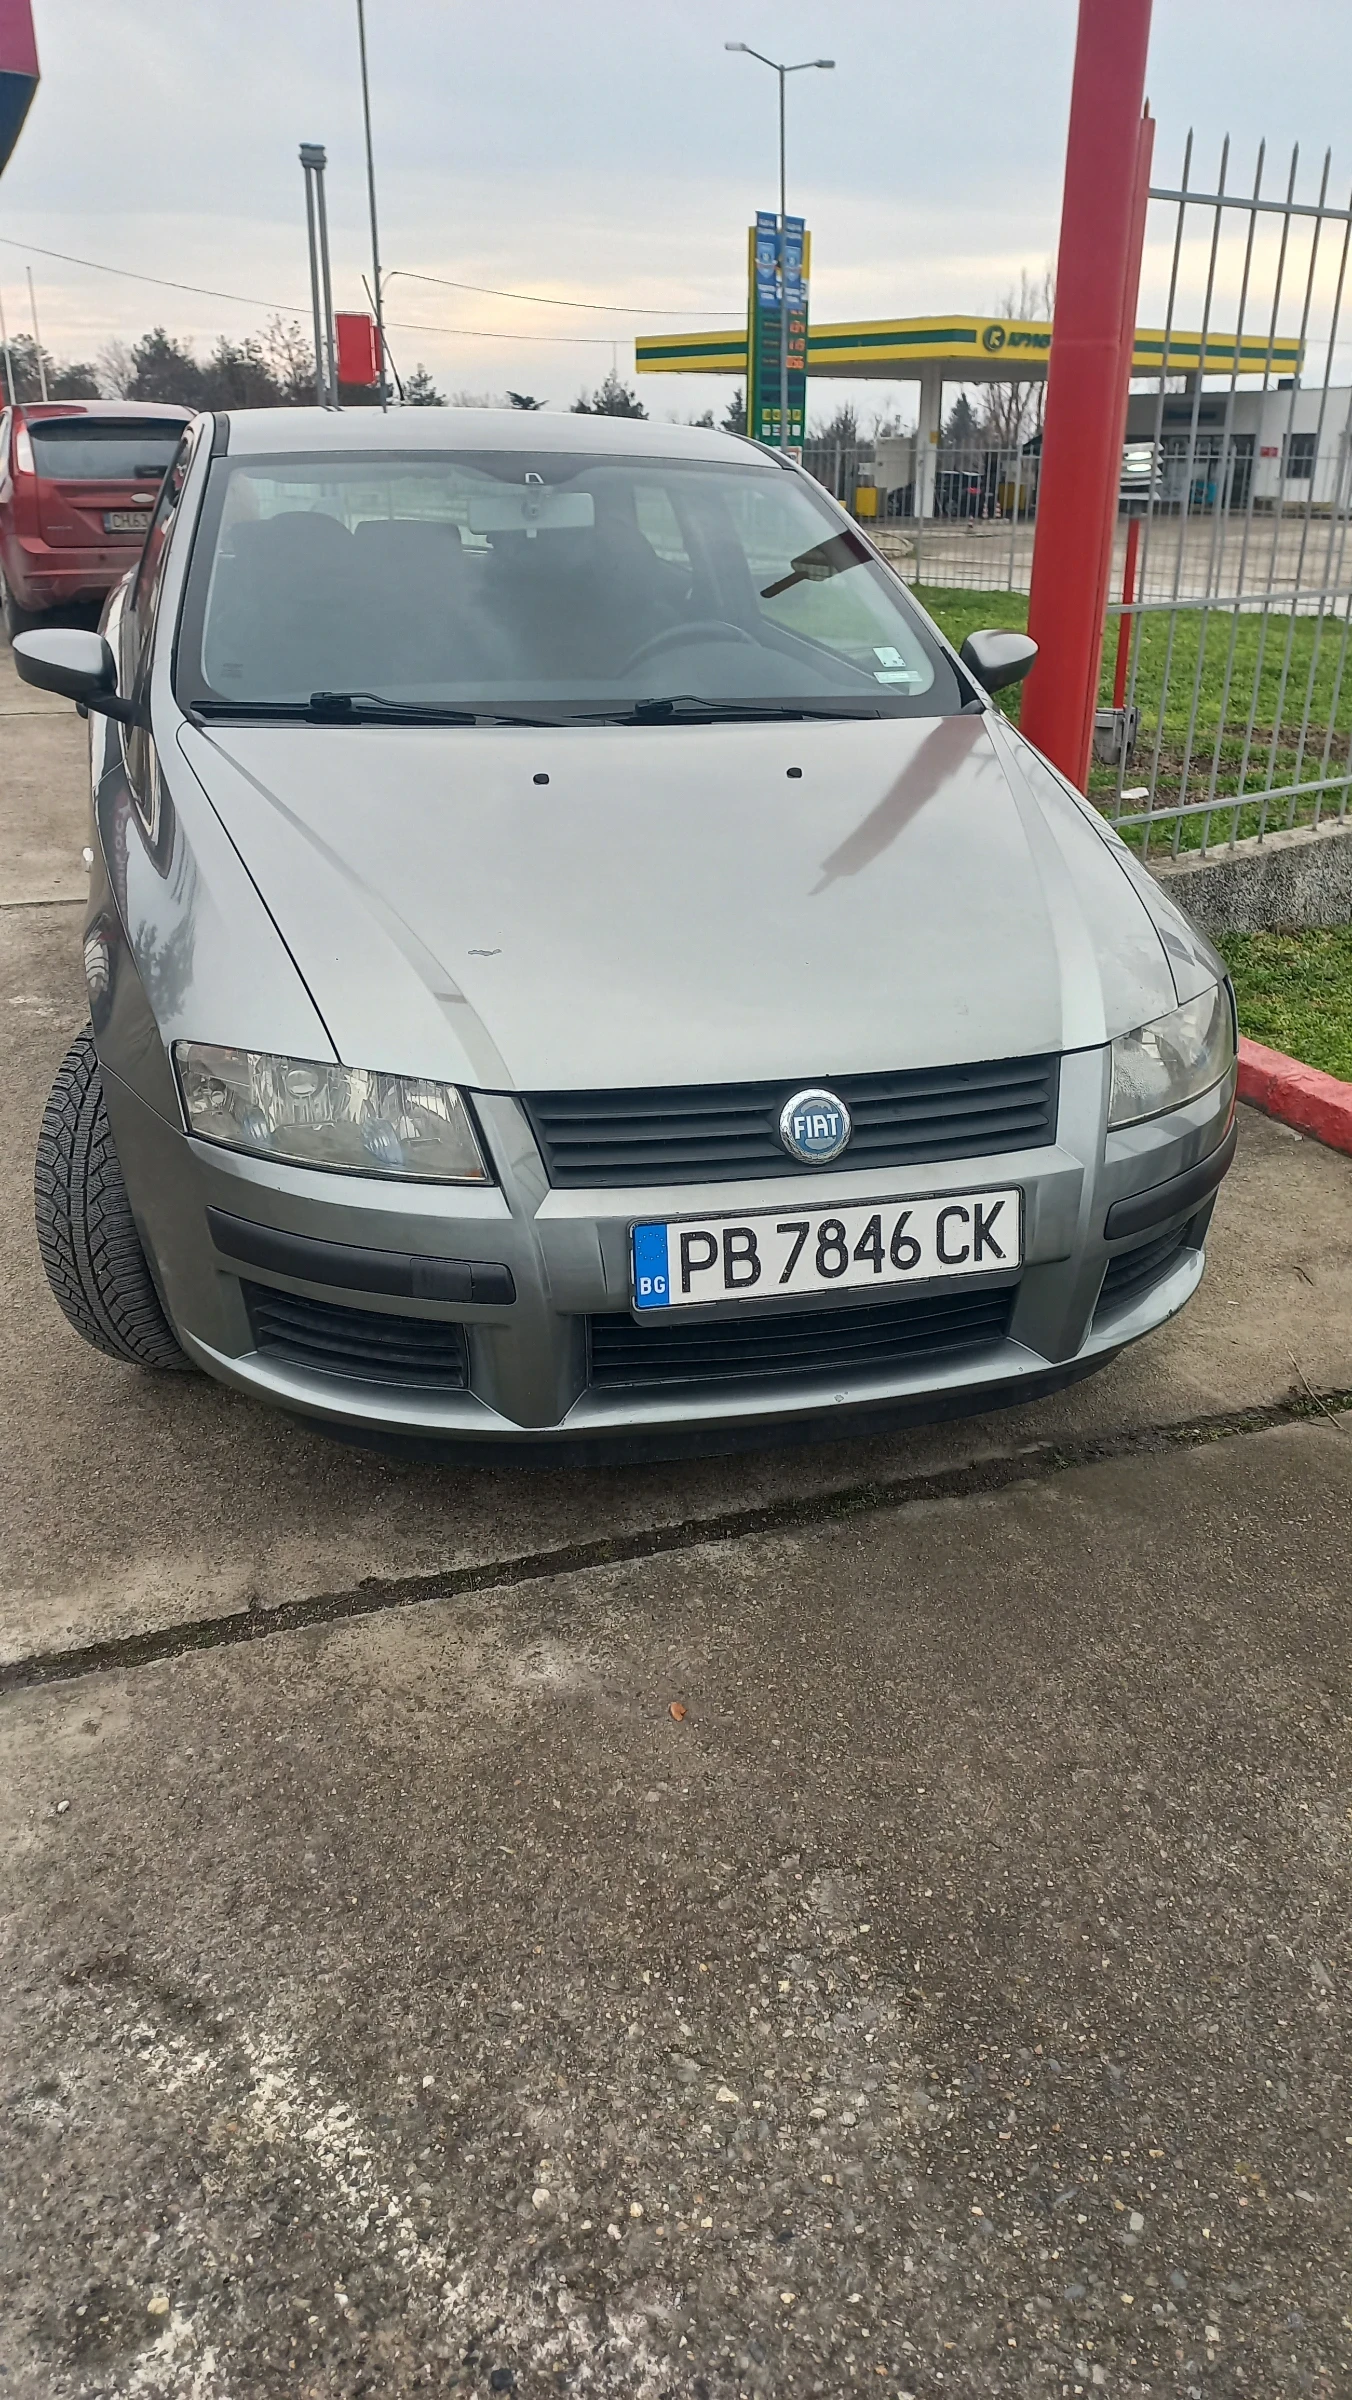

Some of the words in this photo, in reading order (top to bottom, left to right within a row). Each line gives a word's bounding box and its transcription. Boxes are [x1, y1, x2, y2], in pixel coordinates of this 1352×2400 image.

[793, 1113, 840, 1140] FIAT
[680, 1226, 762, 1293] PB
[776, 1210, 922, 1285] 7846
[936, 1200, 1006, 1264] CK
[640, 1275, 666, 1296] BG
